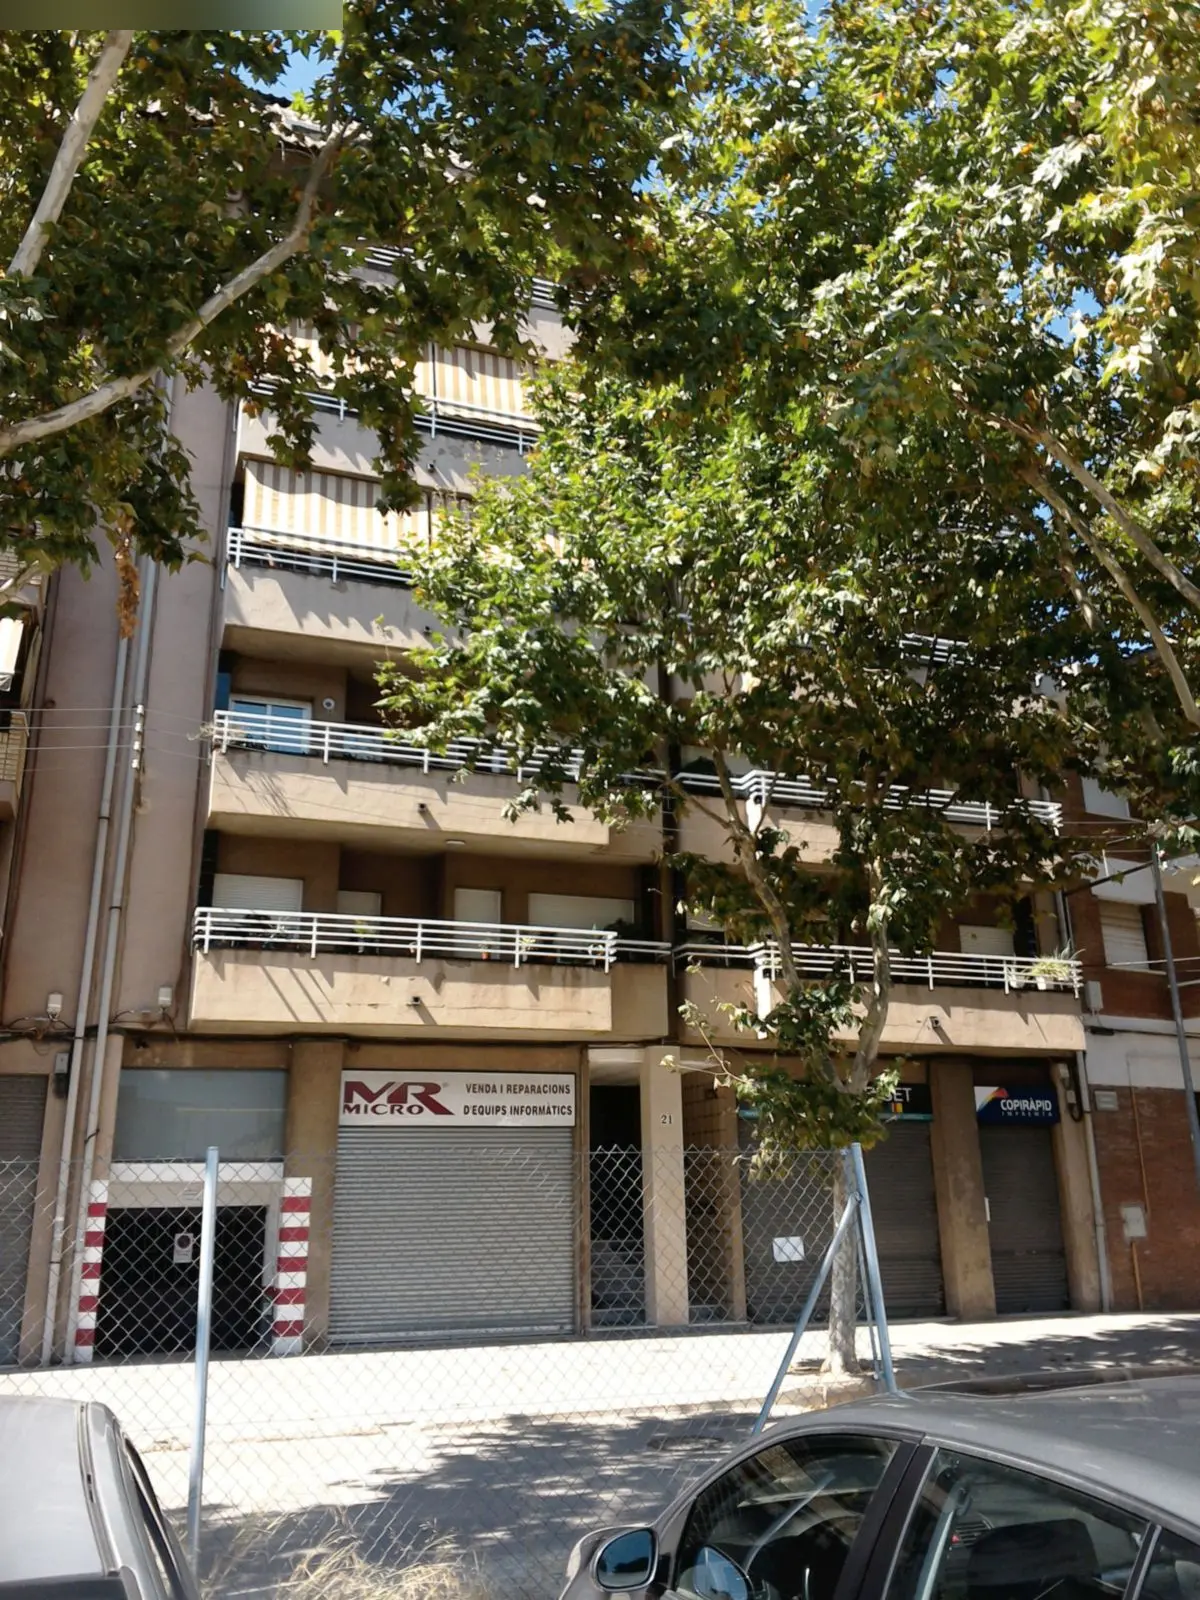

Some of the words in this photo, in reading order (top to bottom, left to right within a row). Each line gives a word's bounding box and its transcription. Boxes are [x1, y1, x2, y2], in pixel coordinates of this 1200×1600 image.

[465, 1083, 497, 1094] VENDA
[500, 1084, 504, 1094] I
[506, 1084, 571, 1094] REPARACIONS
[343, 1103, 424, 1115] MICRO
[463, 1104, 507, 1115] D'EQUIPS
[510, 1102, 573, 1115] INFORMÀTICS
[1000, 1097, 1052, 1111] COPIRÀPID
[660, 1114, 672, 1124] 21
